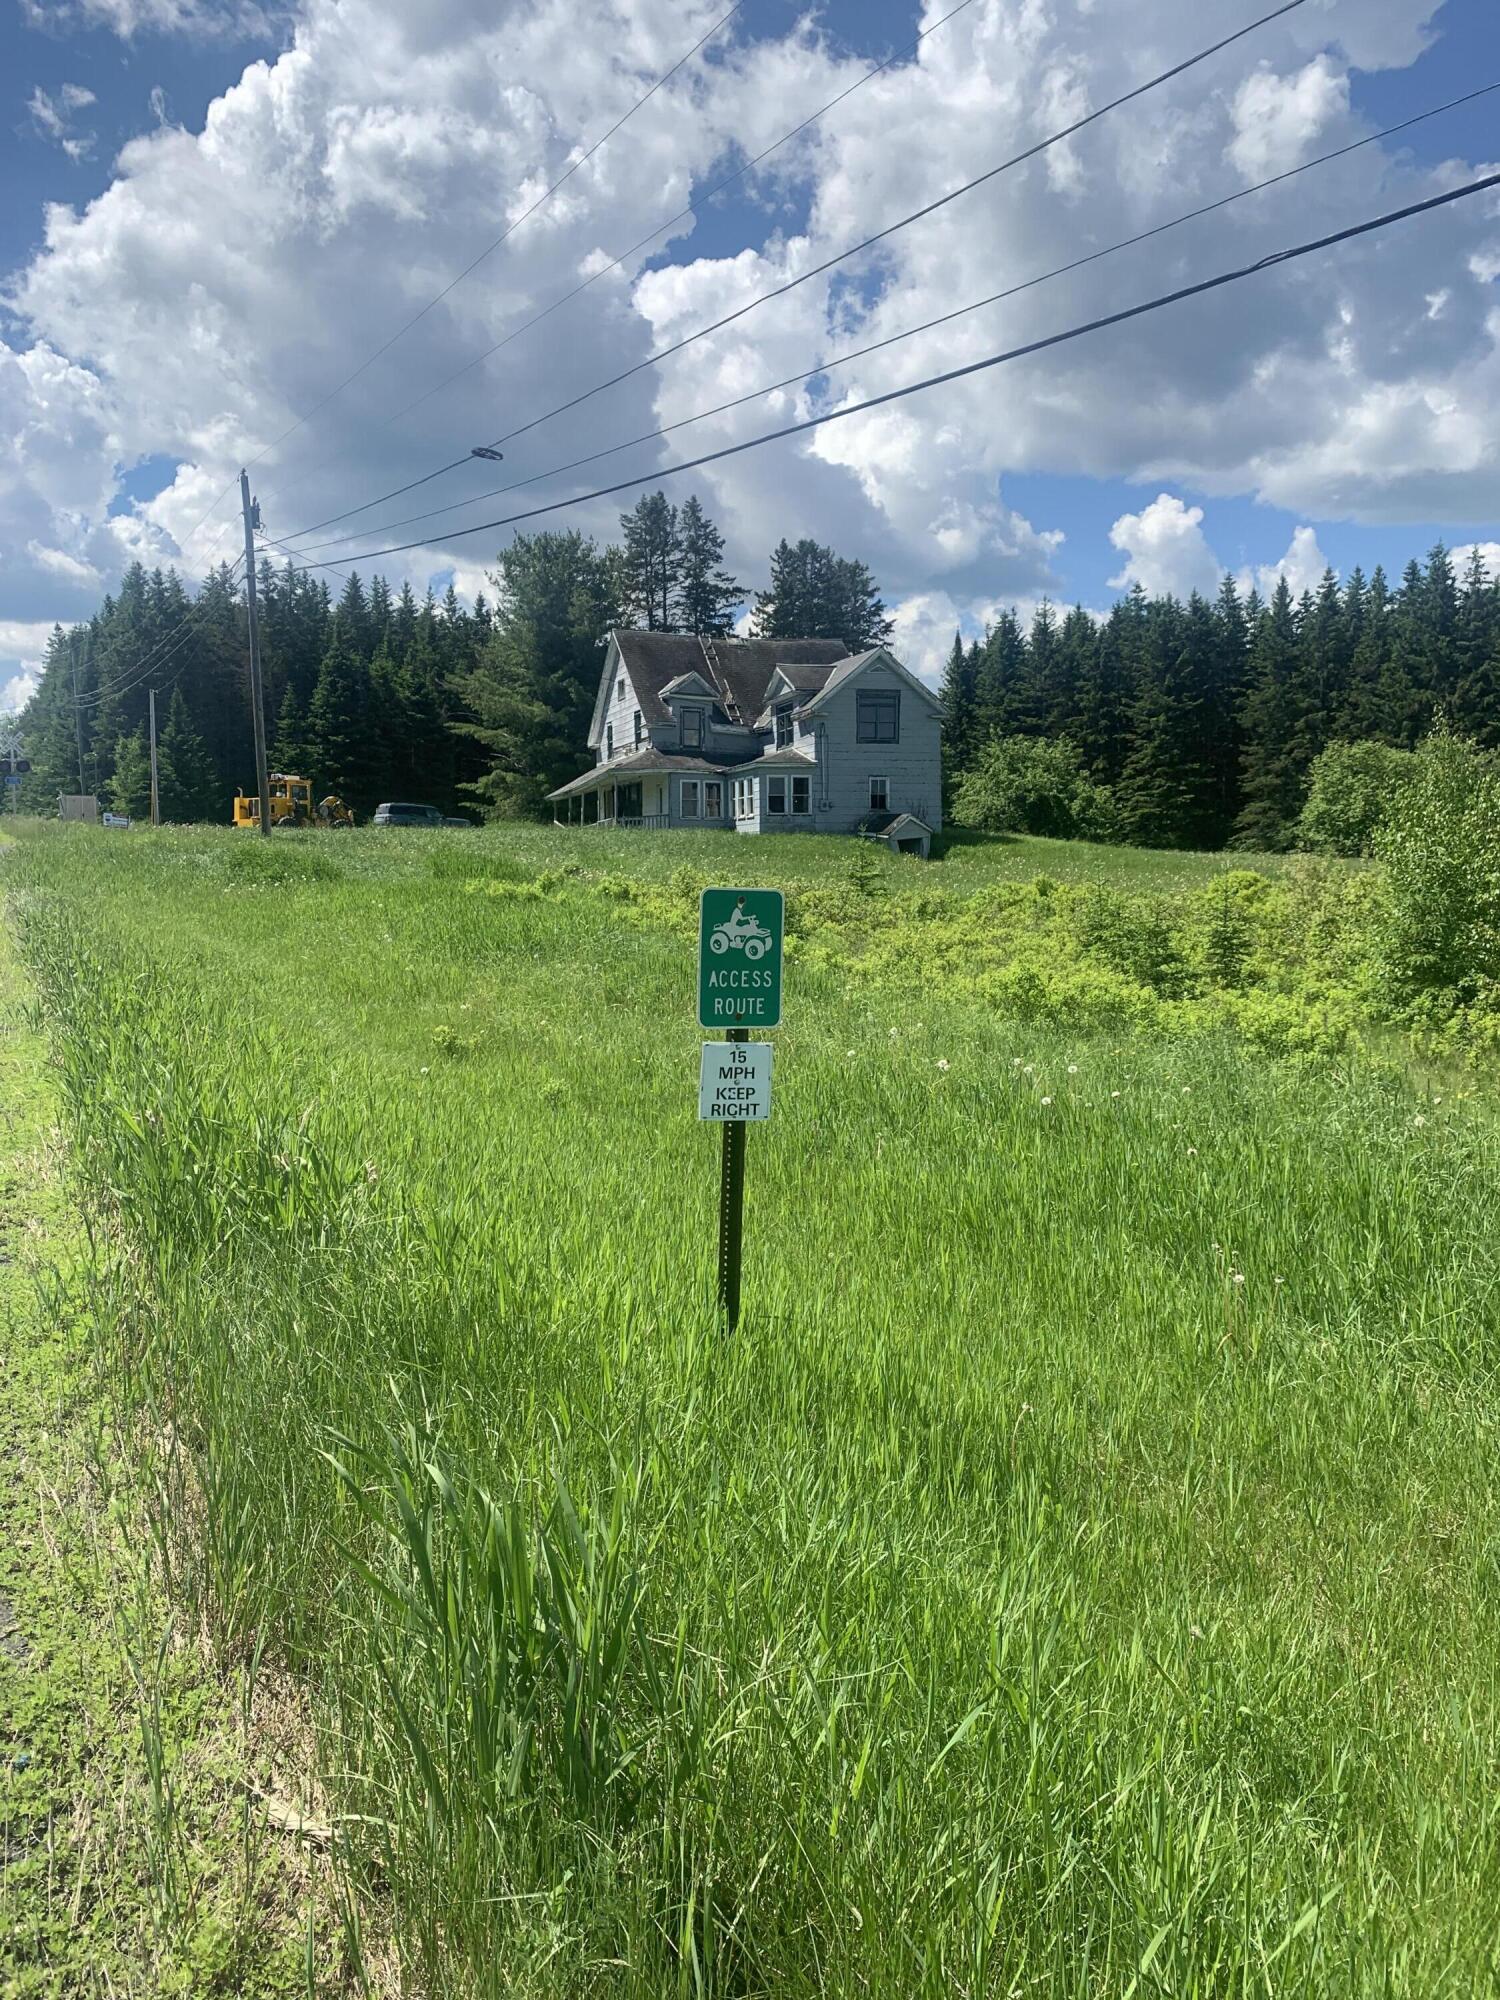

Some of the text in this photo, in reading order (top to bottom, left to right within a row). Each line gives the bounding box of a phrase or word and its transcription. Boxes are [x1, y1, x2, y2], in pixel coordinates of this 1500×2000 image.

[708, 970, 772, 988] ACCESS
[714, 998, 765, 1015] ROUTE
[729, 1051, 747, 1064] 15
[718, 1067, 755, 1080] MPH
[716, 1087, 756, 1100] KEEP
[711, 1103, 760, 1117] RIGHT
